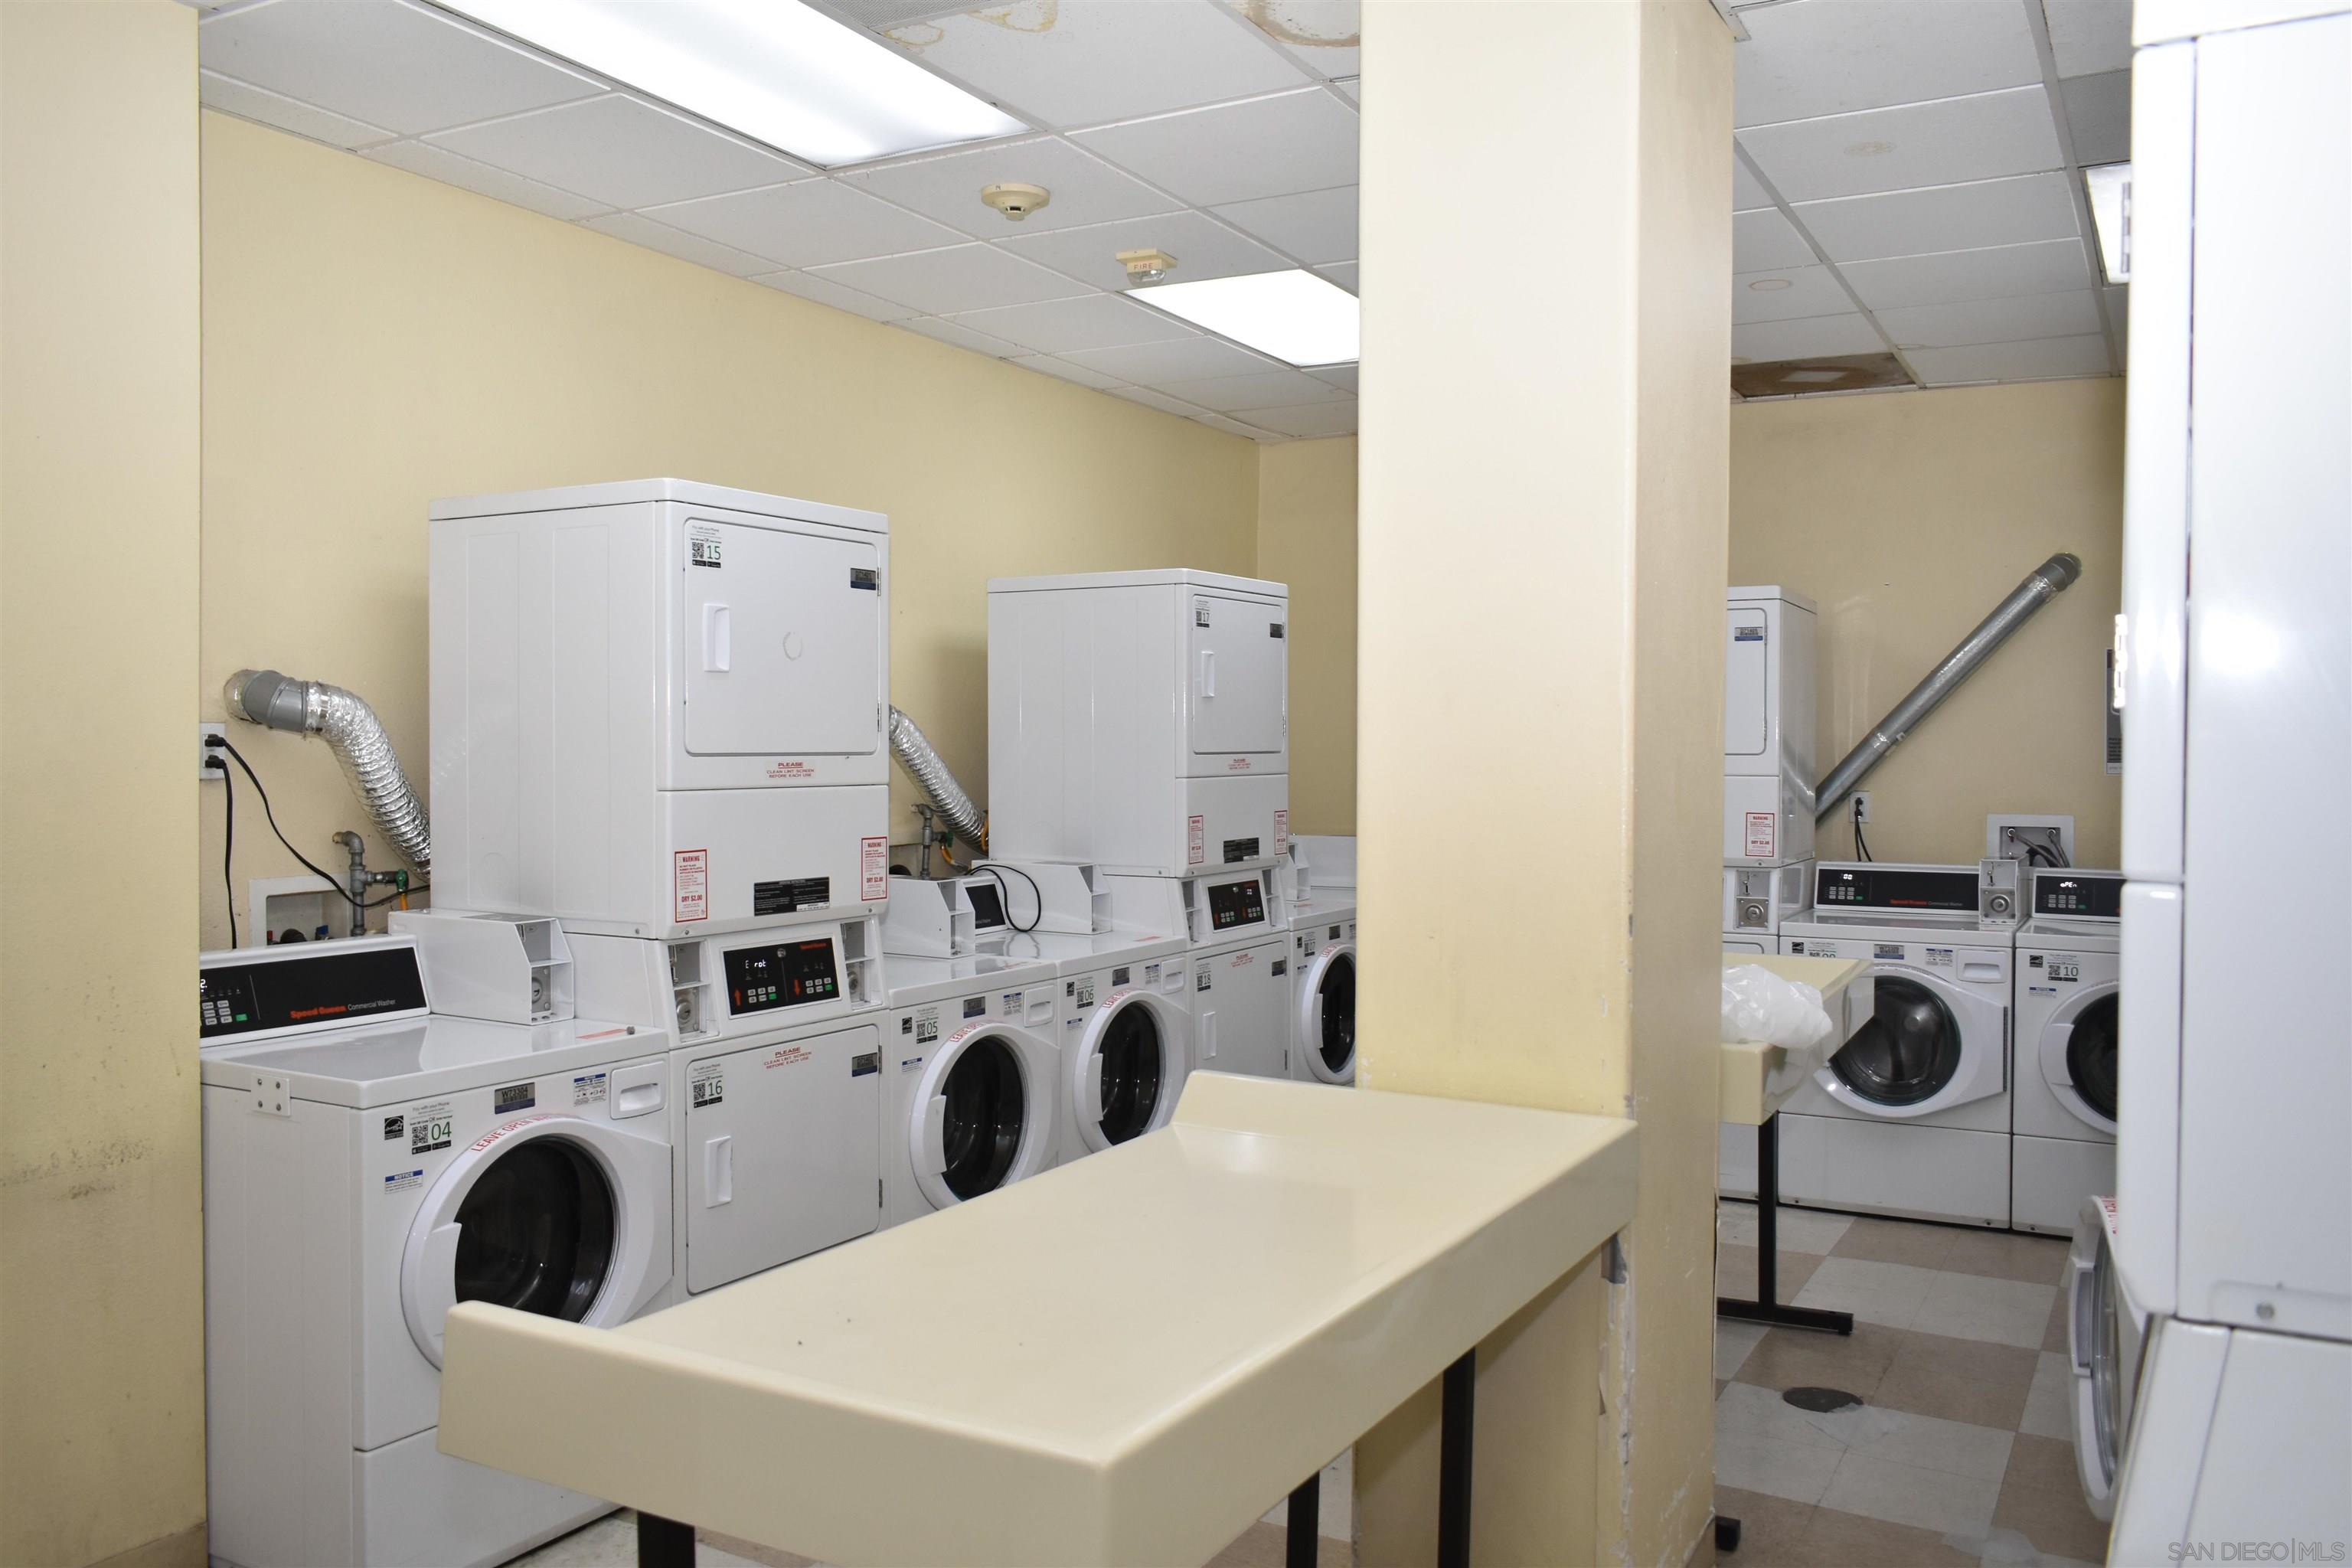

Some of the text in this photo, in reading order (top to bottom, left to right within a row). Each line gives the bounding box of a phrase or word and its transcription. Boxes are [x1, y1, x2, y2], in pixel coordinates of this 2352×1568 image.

[707, 545, 721, 560] 15
[1203, 612, 1210, 622] 17
[2063, 966, 2079, 977] 10
[1204, 974, 1211, 985] 18
[1084, 988, 1094, 1001] 06
[290, 1008, 318, 1019] Speed
[318, 1005, 347, 1014] Queen
[348, 1001, 376, 1011] Commercial
[926, 1021, 938, 1034] 05
[775, 1047, 801, 1057] PLEASE
[707, 1080, 723, 1096] 16
[431, 1121, 452, 1141] 04
[471, 1131, 505, 1152] LEAVE
[502, 1118, 534, 1133] OPEN
[395, 1171, 413, 1179] NOTICE
